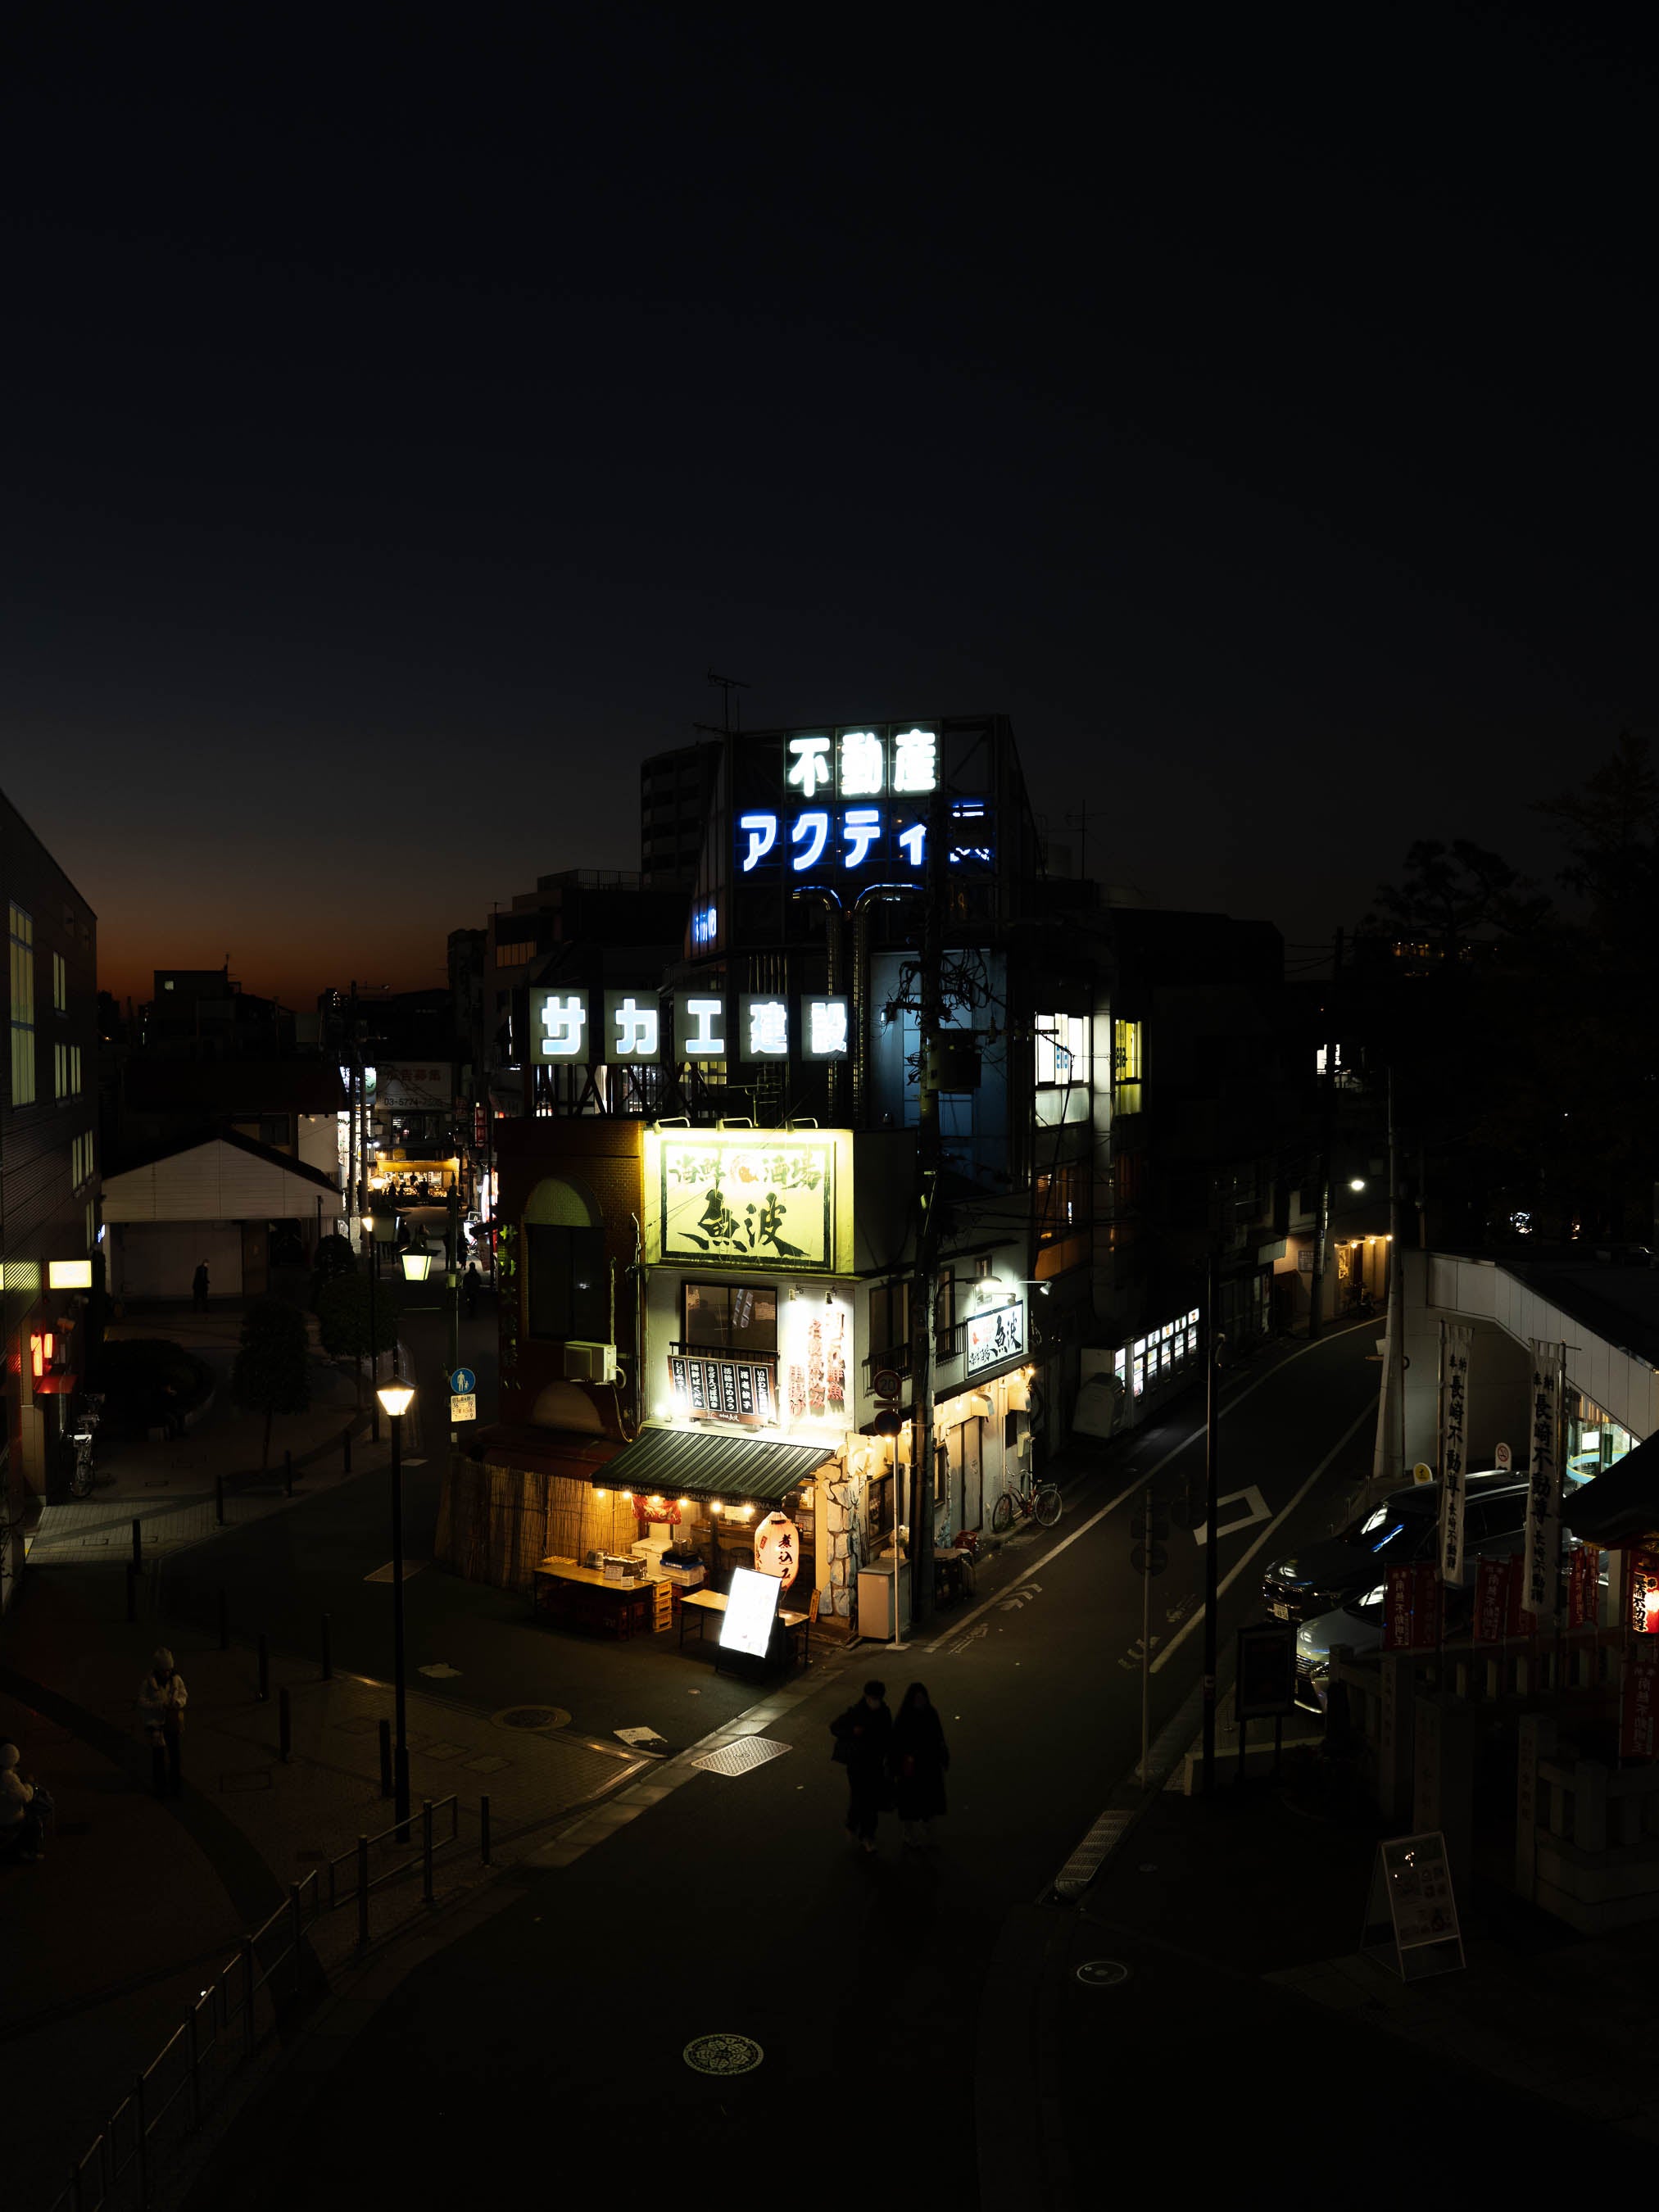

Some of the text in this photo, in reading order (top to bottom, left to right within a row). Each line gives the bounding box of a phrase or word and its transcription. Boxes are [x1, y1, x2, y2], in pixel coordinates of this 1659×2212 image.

[788, 728, 937, 797] 不動産
[541, 995, 848, 1055] サカエ建設
[668, 1153, 823, 1191] 海鮮 酒場
[676, 1189, 819, 1258] 魚波
[879, 1378, 896, 1392] 20
